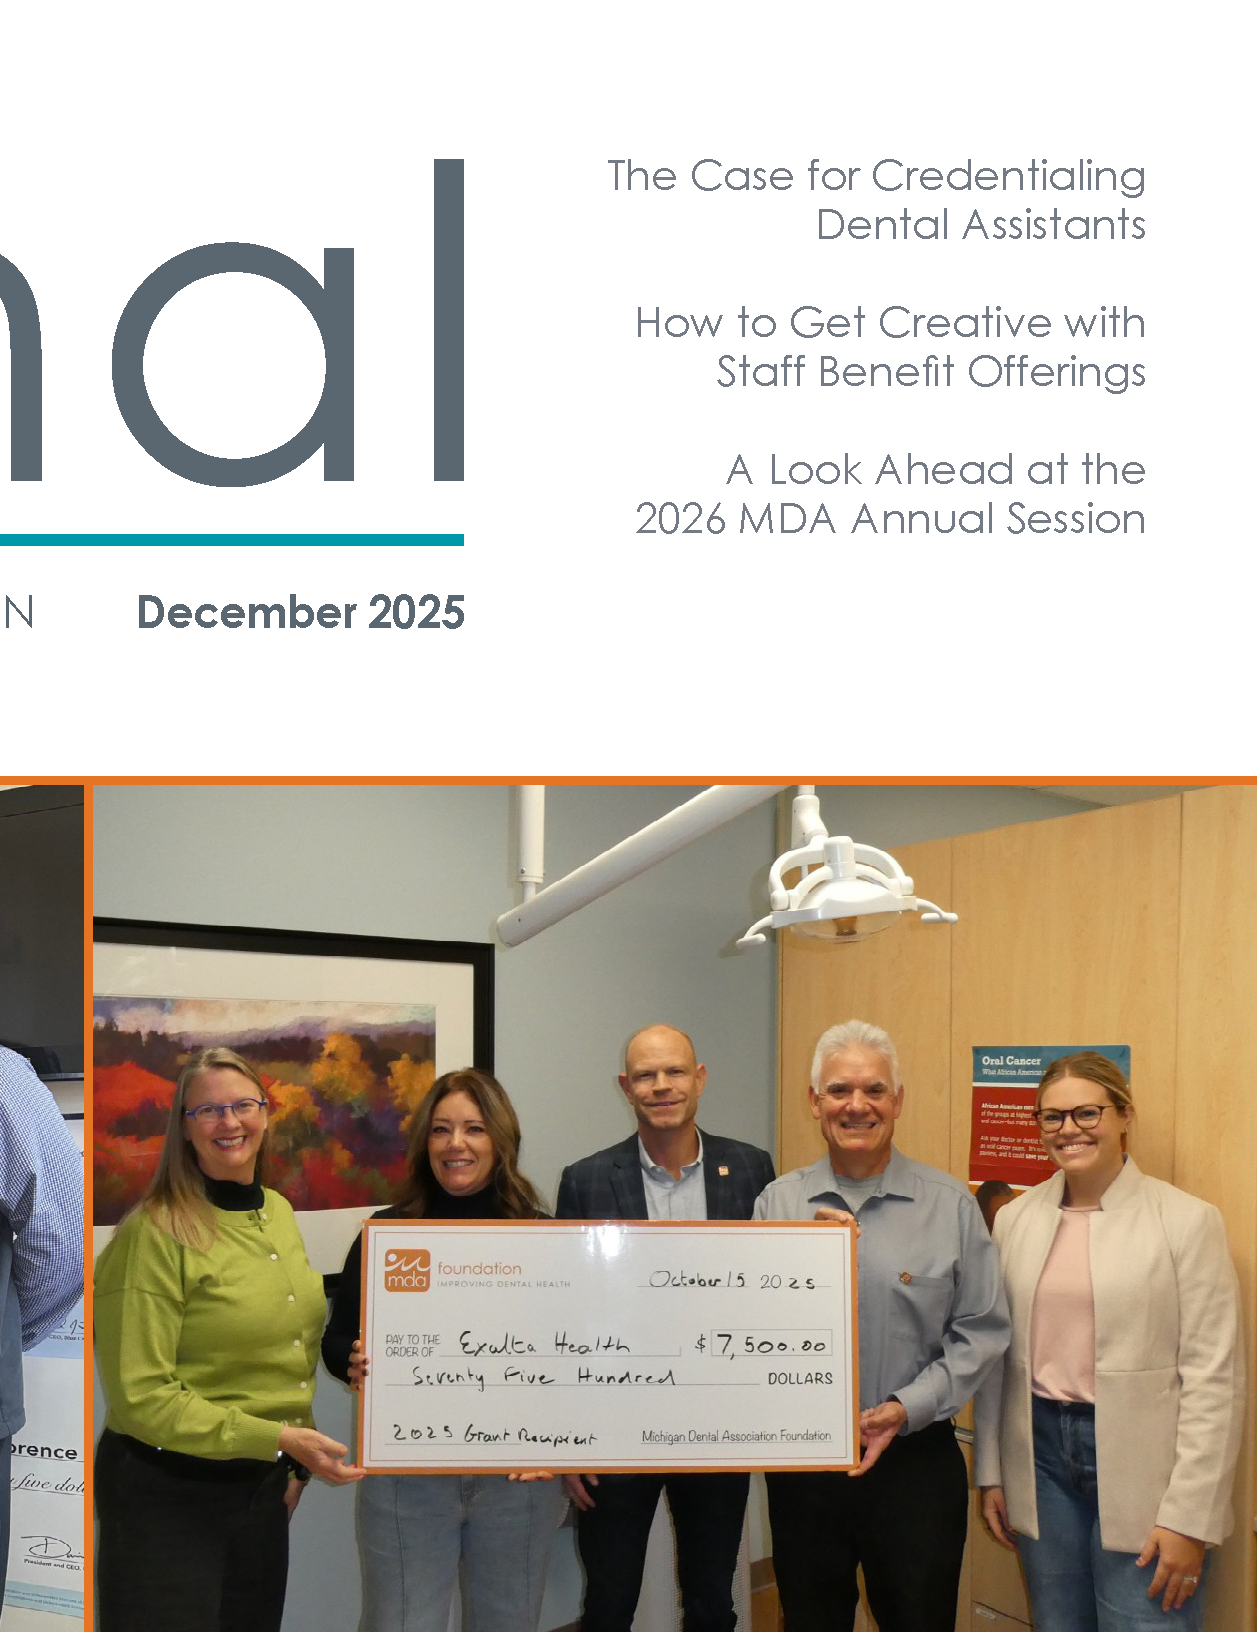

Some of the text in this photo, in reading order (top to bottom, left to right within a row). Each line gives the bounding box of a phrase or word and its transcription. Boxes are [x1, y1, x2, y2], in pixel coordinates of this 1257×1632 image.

[982, 1056, 1041, 1065] Oral Cancer
[438, 1262, 521, 1275] foundation
[388, 1271, 426, 1287] mda
[649, 1270, 721, 1287] October
[727, 1271, 745, 1287] 15
[386, 1335, 440, 1344] PAY TO THE
[460, 1331, 630, 1357] Exalta Health
[695, 1334, 706, 1353] $
[386, 1347, 434, 1357] ORDER OF
[413, 1366, 675, 1392] Seventy Five Hundred
[768, 1372, 833, 1385] DOLLARS
[394, 1424, 452, 1440] 2025
[464, 1424, 510, 1442] Grant
[642, 1429, 831, 1445] Michigan Dental Association Foundation
